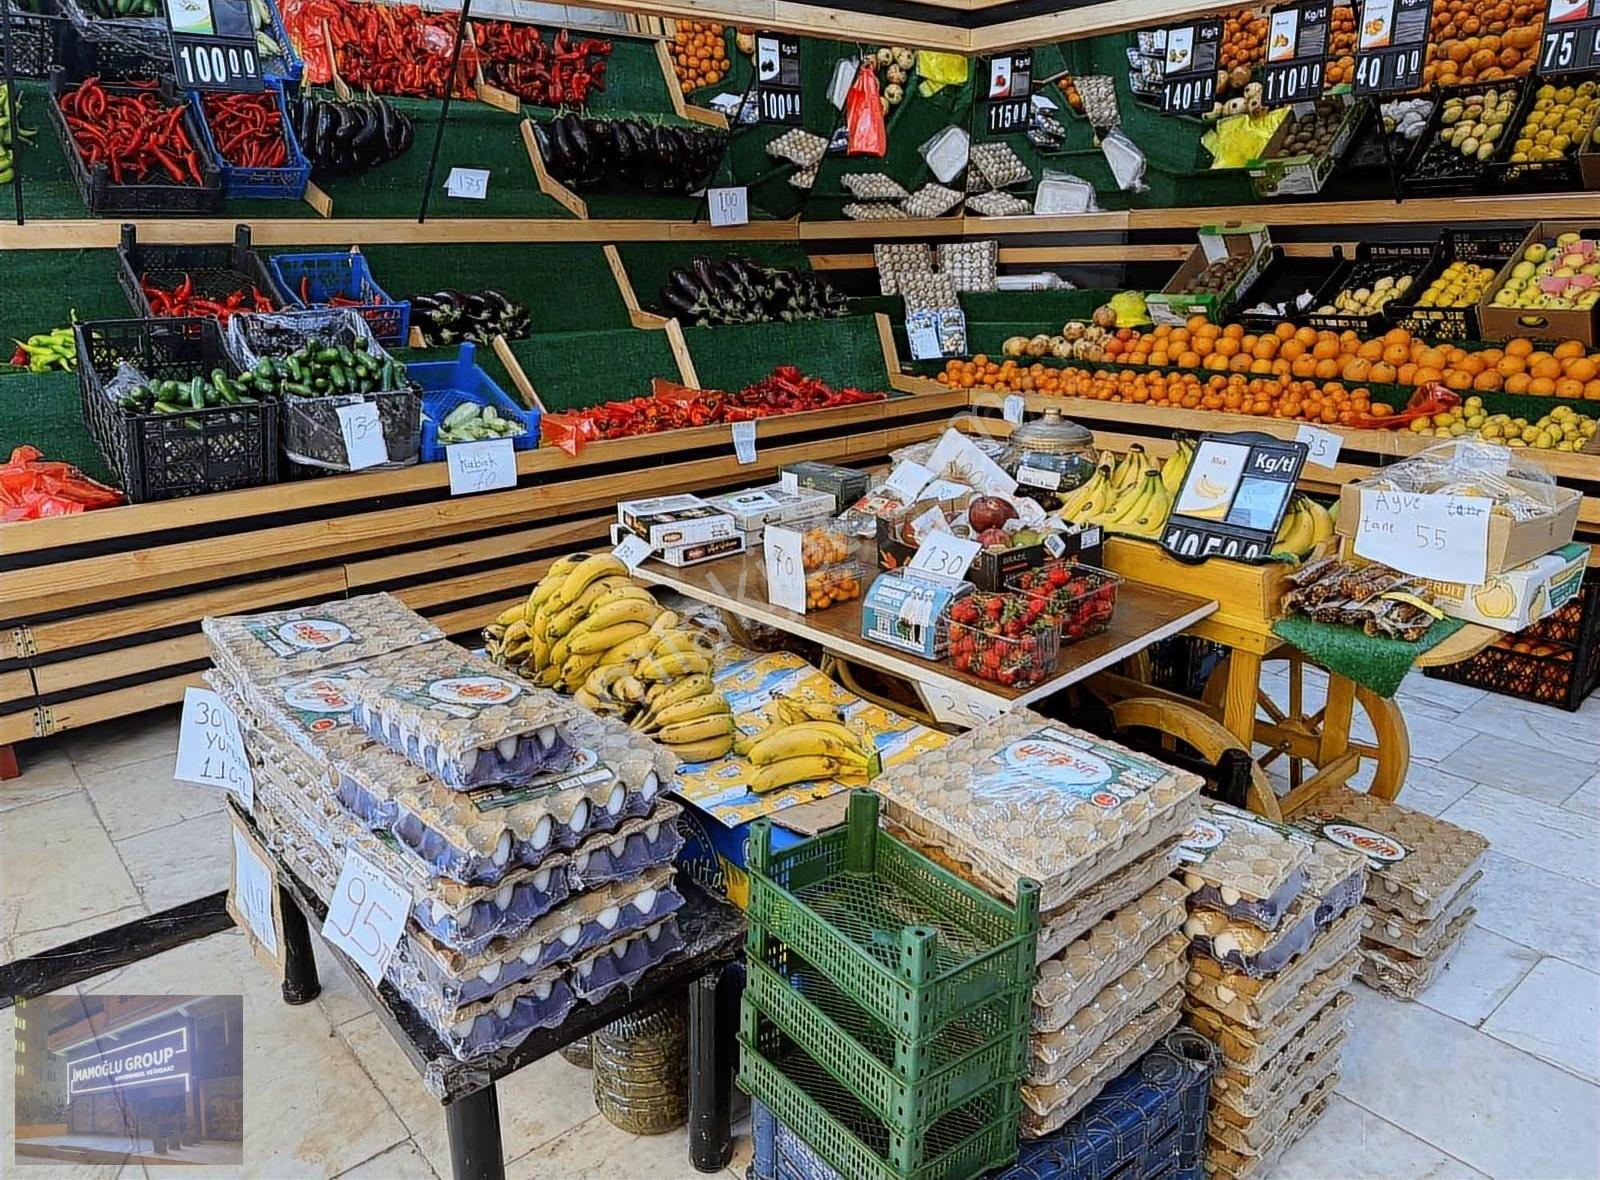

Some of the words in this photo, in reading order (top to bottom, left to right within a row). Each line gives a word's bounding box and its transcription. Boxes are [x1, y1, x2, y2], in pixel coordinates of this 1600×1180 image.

[1543, 32, 1575, 68] 75
[1356, 57, 1381, 88] 40
[1254, 452, 1297, 473] Kg/tl
[1416, 524, 1448, 550] 55
[773, 544, 794, 576] 70
[922, 546, 963, 575] 130
[328, 877, 393, 957] 95
